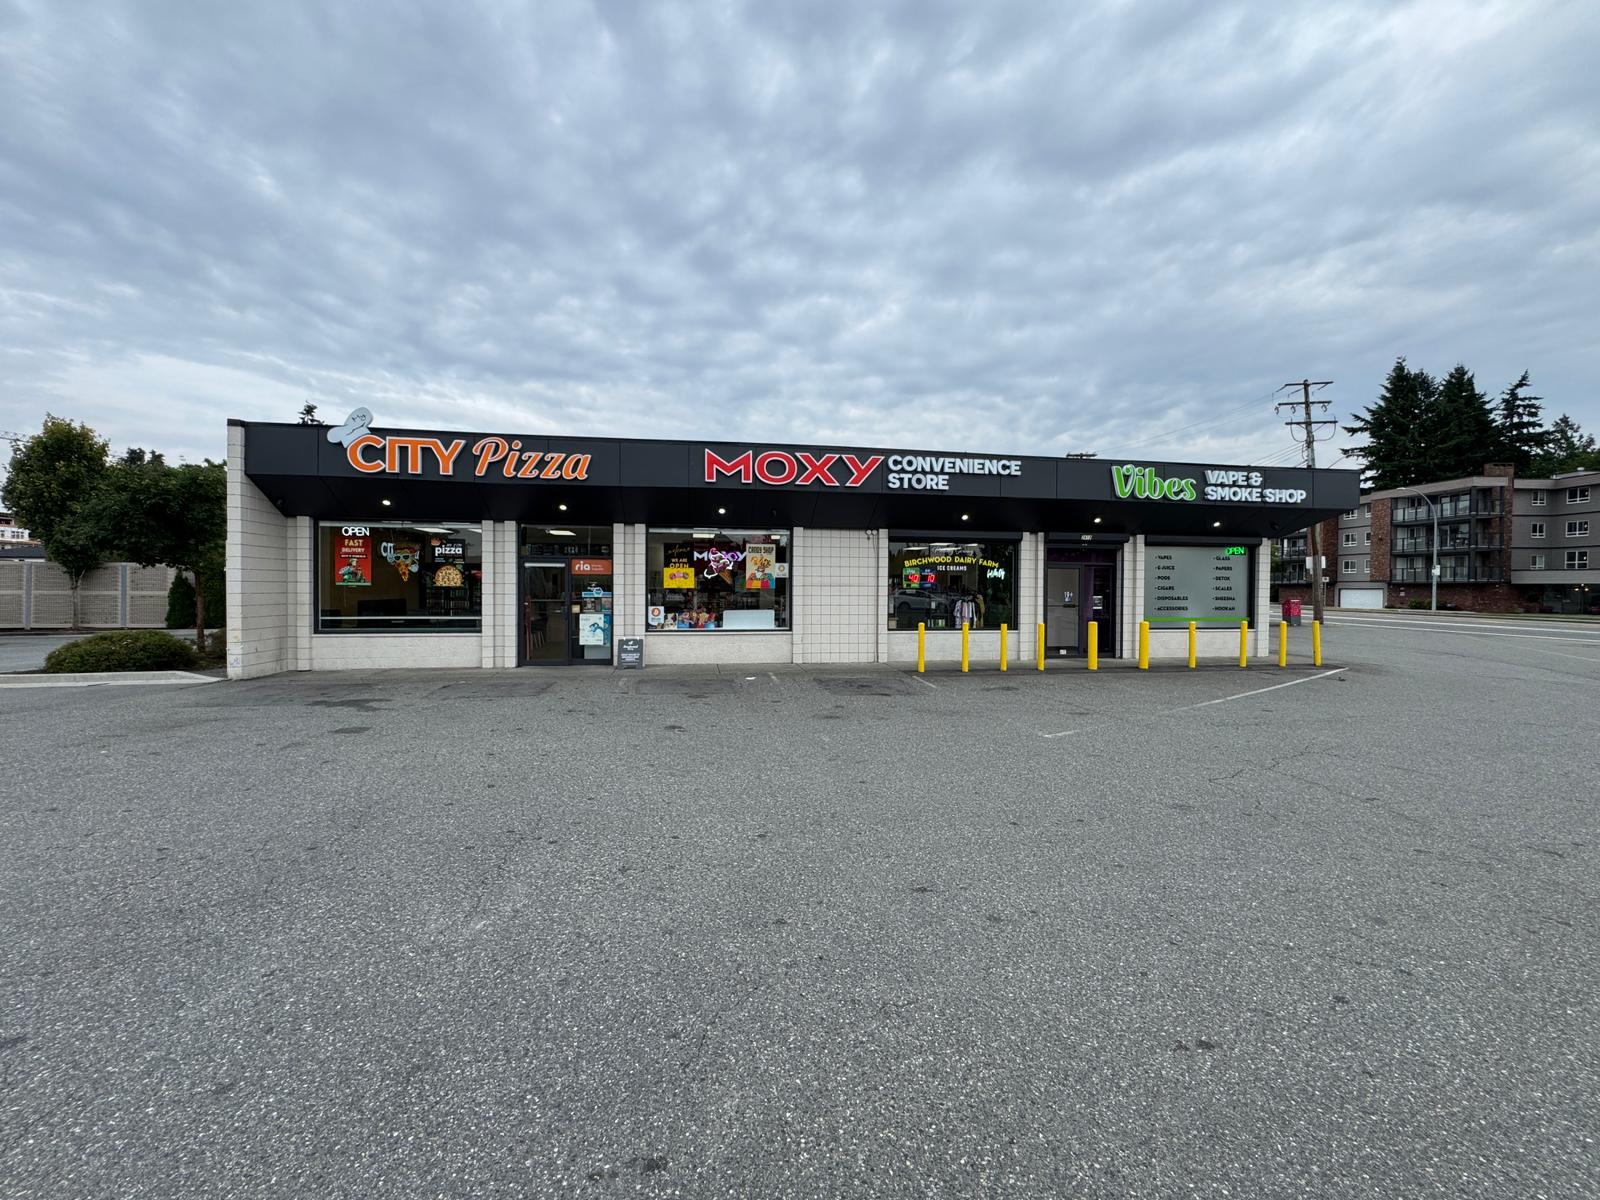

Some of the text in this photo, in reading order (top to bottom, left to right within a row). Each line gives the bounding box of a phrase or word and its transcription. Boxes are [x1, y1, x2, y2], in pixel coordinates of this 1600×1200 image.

[347, 435, 591, 480] CITY Pizza
[888, 455, 1022, 476] CONVENIENCE
[704, 448, 885, 487] MOXY
[888, 474, 949, 491] STORE
[1111, 464, 1197, 501] Vibes
[1205, 470, 1263, 486] VAPE &
[1205, 486, 1306, 503] SMOKE SHOP
[342, 527, 370, 537] OPEN
[435, 545, 463, 557] pizza
[1225, 547, 1245, 555] OPEN
[575, 561, 591, 571] ria
[904, 556, 1000, 568] BIRCHWOOD DAIRY FARM
